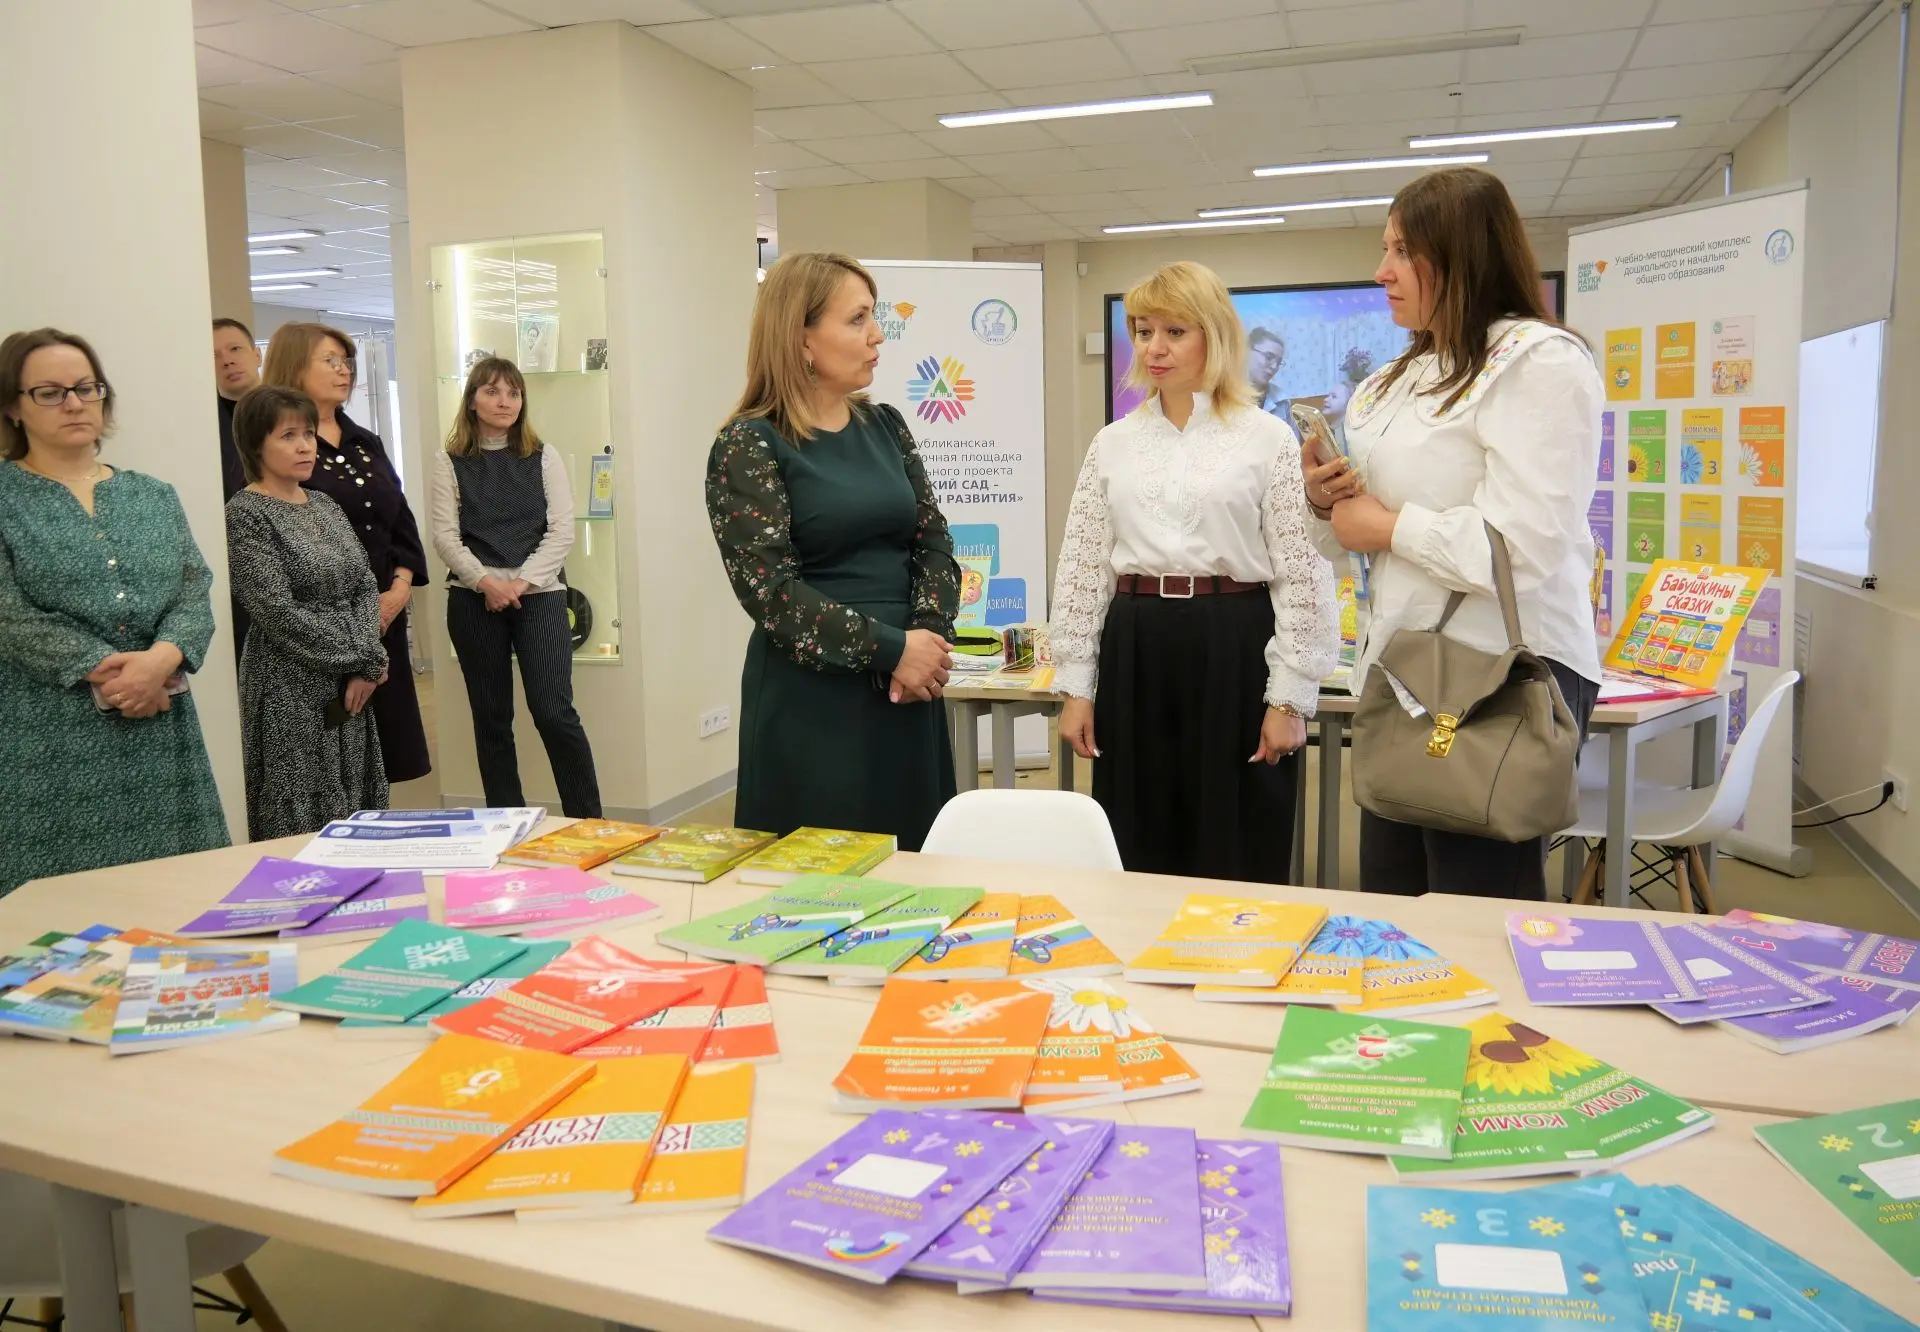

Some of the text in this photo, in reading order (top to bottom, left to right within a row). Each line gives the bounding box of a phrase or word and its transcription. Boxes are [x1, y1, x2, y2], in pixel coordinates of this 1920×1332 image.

[1614, 235, 1751, 266] Учебно-методический комплекс
[1623, 250, 1739, 277] дошкольного и начального
[1636, 265, 1725, 285] общего образования
[1578, 284, 1599, 293] КОМИ
[961, 453, 1022, 463] площадка
[964, 467, 1013, 476] проекта
[1654, 460, 1663, 475] 2
[1708, 460, 1718, 475] 3
[961, 480, 989, 491] САД
[946, 493, 1024, 504] РАЗВИТИЯ»
[1695, 544, 1702, 557] 3
[1659, 574, 1736, 599] Бабушкины
[1232, 913, 1259, 926] 3
[1387, 969, 1456, 985] КОМИ
[1358, 1035, 1389, 1058] 2
[1572, 1084, 1650, 1120] КОМИ
[1300, 1120, 1360, 1131] Полякова
[1470, 1111, 1569, 1134] КОМИ
[1856, 1122, 1904, 1148] 2
[1476, 1208, 1510, 1237] 3
